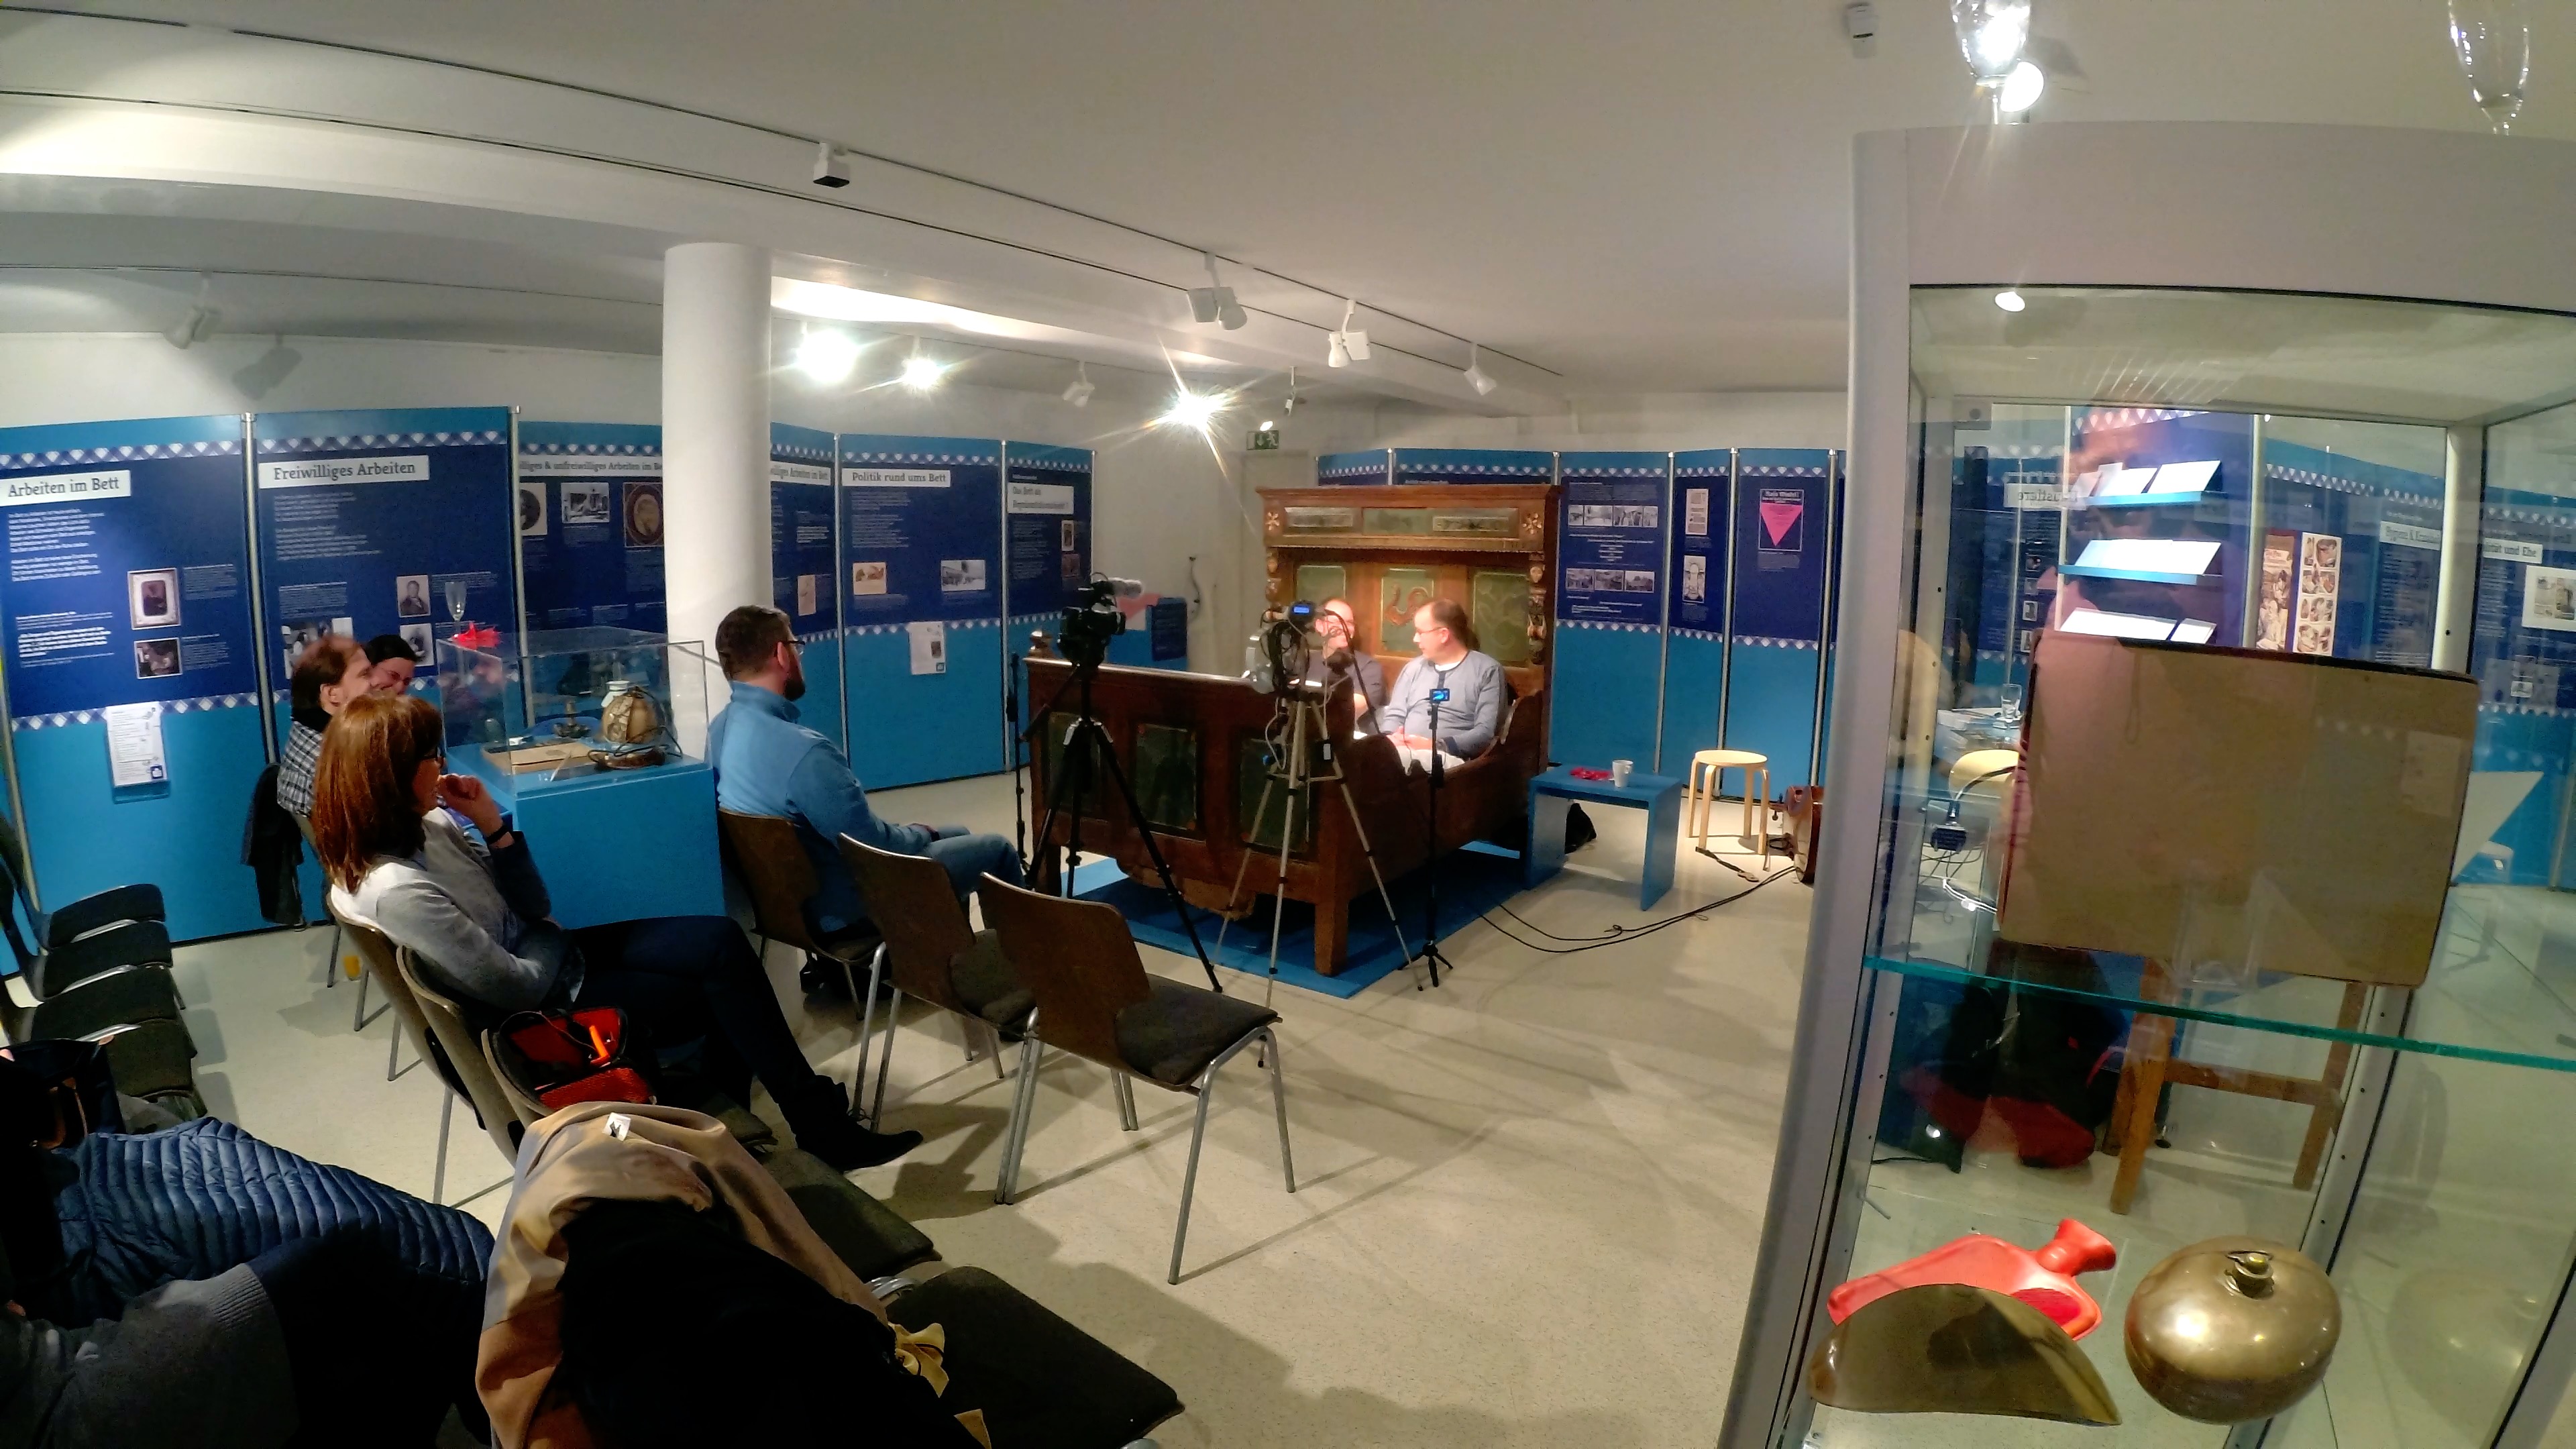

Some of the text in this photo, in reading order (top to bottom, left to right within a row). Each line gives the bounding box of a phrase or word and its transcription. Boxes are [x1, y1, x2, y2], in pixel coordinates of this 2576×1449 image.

[274, 462, 416, 481] Freiwilliges Arbeiten
[852, 472, 881, 482] Politik
[884, 473, 906, 482] rund
[929, 474, 947, 483] Bett
[8, 477, 119, 498] Arbeiten im Bett
